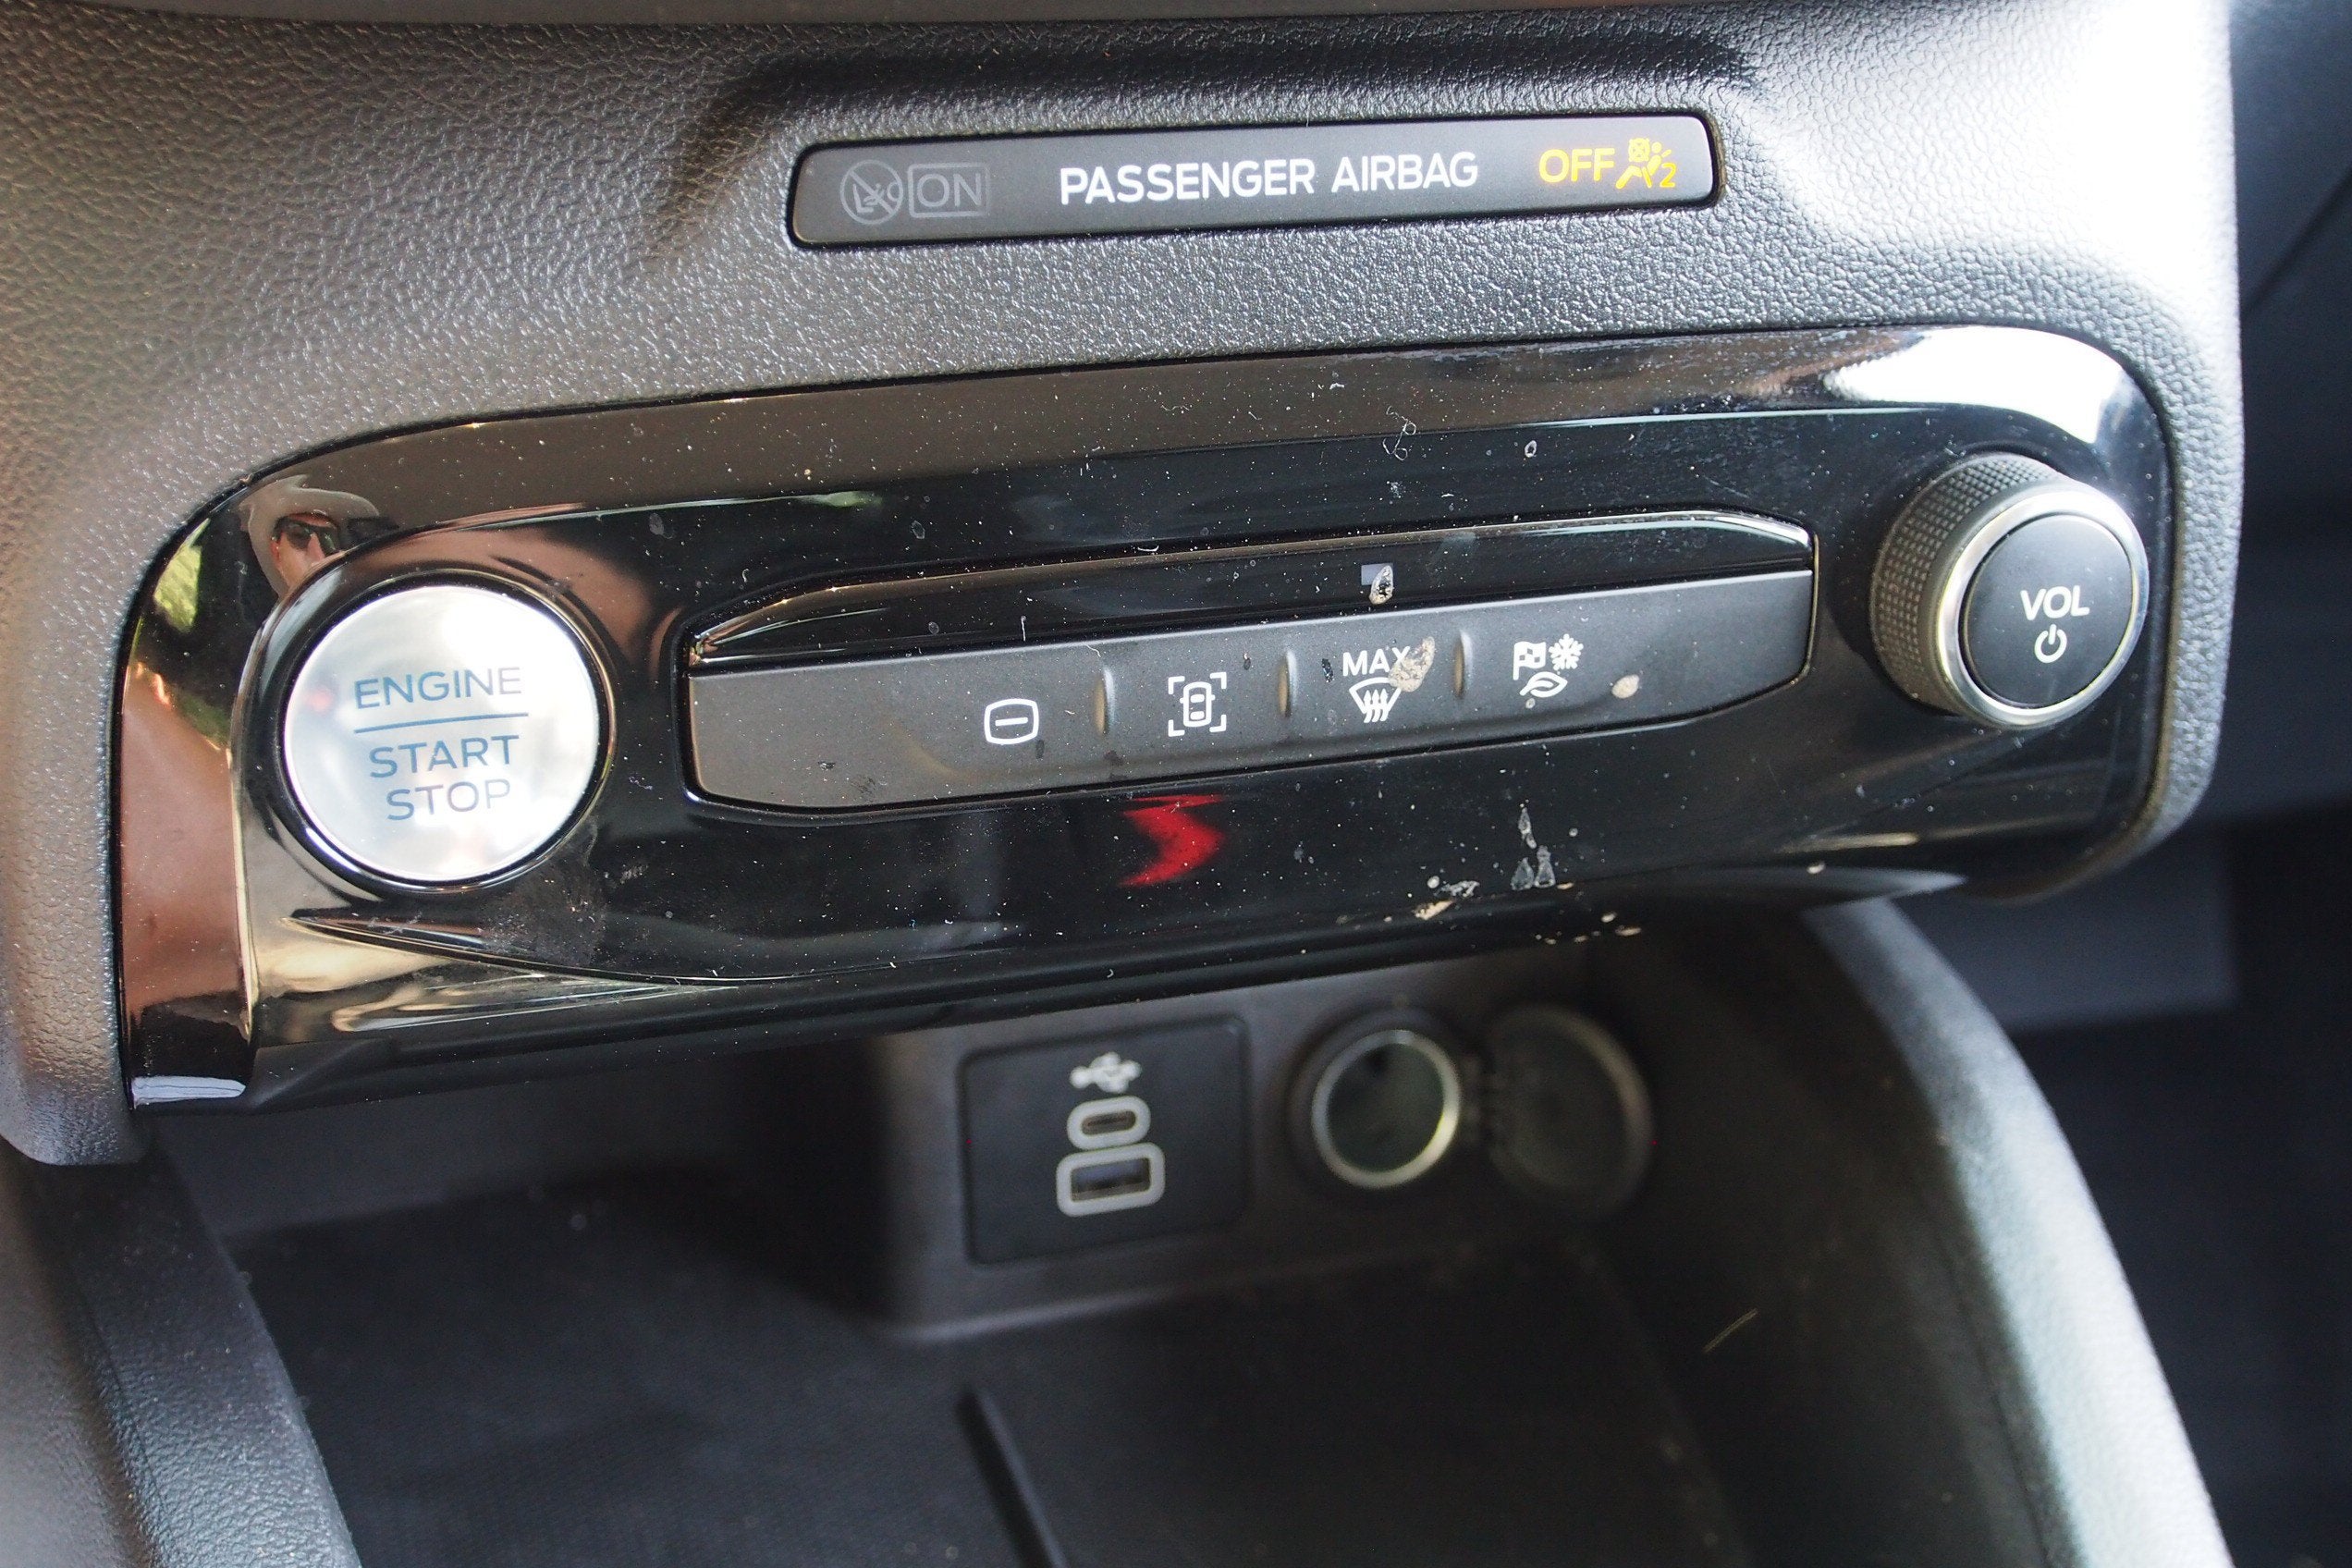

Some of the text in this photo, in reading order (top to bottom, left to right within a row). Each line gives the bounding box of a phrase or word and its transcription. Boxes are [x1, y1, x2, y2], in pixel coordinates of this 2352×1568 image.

[1060, 151, 1479, 205] PASSENGER AIRBAG
[1538, 147, 1616, 183] OFF
[916, 173, 982, 208] ON
[2020, 584, 2090, 621] VOL
[1342, 645, 1411, 677] MAX
[353, 667, 522, 710] ENGINE
[370, 734, 520, 778] START
[386, 778, 510, 821] STOP
